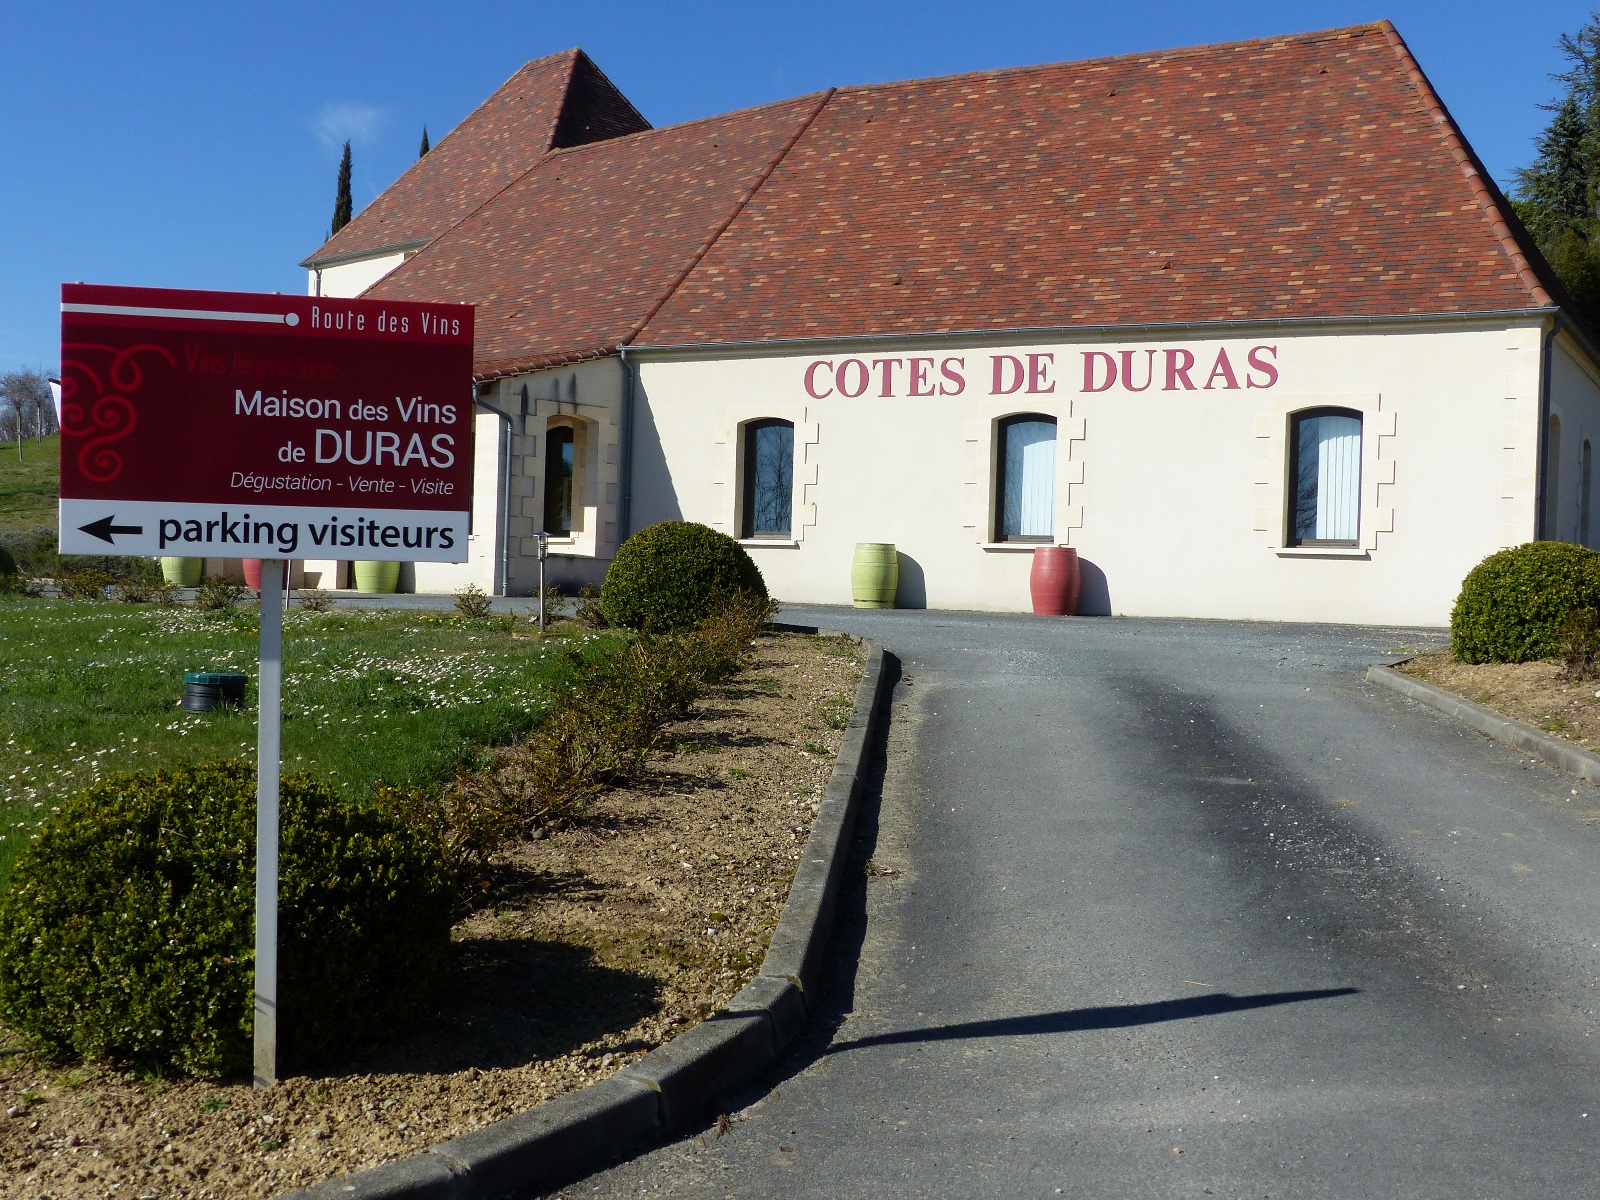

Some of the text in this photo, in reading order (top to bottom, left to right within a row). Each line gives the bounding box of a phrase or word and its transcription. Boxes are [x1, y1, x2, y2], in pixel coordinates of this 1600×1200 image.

[311, 306, 460, 336] Route des Vins
[803, 345, 1279, 399] COTES DE DURAS
[235, 389, 457, 425] Maison des Vins
[278, 429, 456, 469] de DURAS
[230, 471, 332, 493] Dégustation
[348, 476, 395, 493] Vente
[411, 479, 454, 495] Visite
[159, 511, 455, 554] parking visiteurs
